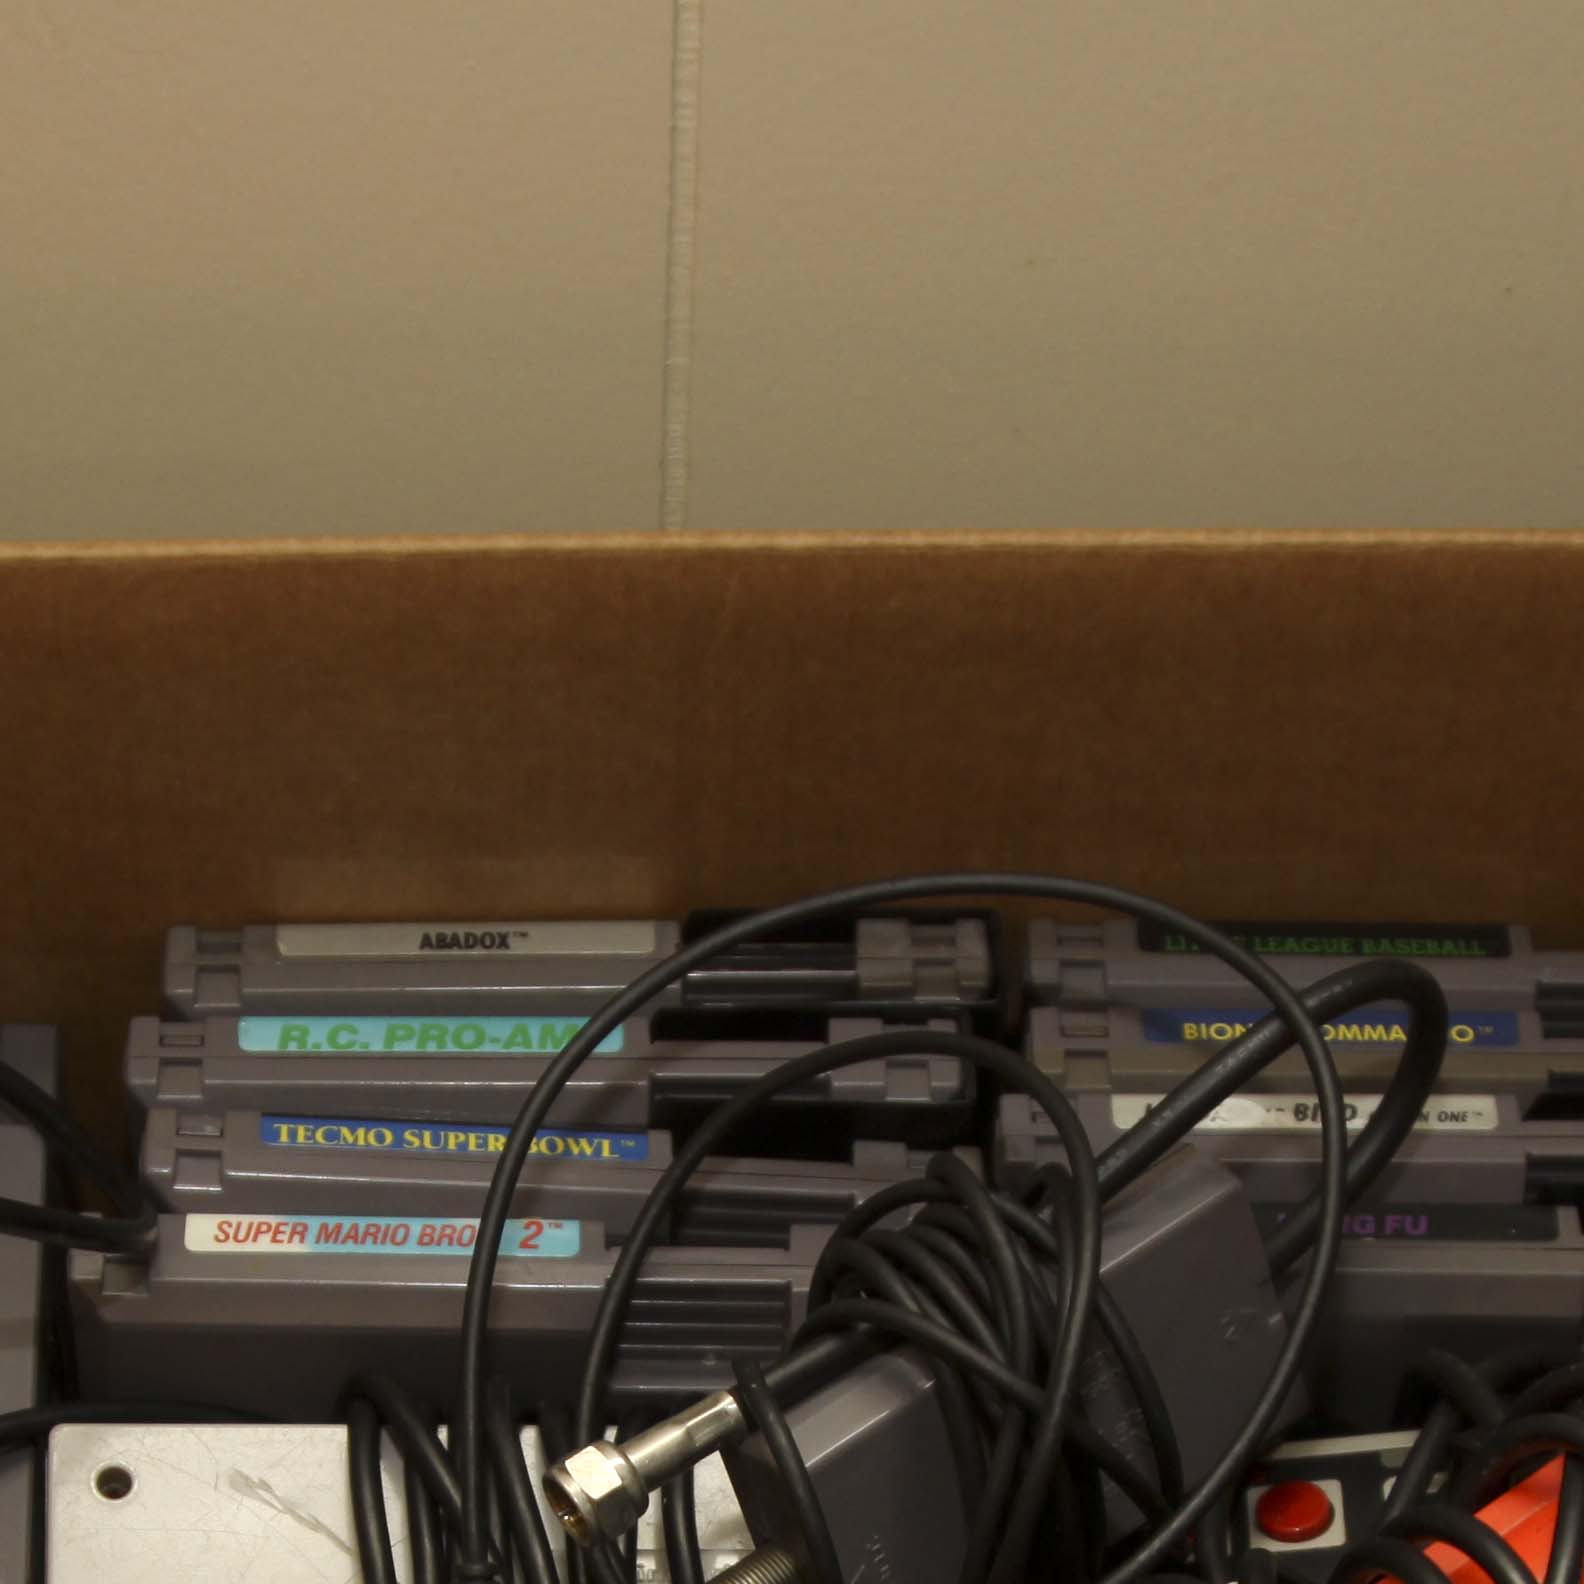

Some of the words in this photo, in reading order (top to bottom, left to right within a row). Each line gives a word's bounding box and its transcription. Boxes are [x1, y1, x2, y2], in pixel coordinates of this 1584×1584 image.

[419, 932, 510, 950] ABADOX
[1254, 936, 1351, 953] LEAGUE
[1361, 938, 1486, 956] BASEBALL
[278, 1024, 369, 1050] R.C.
[383, 1024, 579, 1050] PRO-AM
[1438, 1111, 1469, 1122] ONE
[273, 1123, 393, 1147] TECMO
[403, 1129, 507, 1151] SUPER
[214, 1220, 307, 1244] SUPER
[315, 1222, 410, 1246] MARIO
[417, 1224, 477, 1247] BRO
[519, 1220, 544, 1249] 2
[1384, 1215, 1429, 1235] FU
